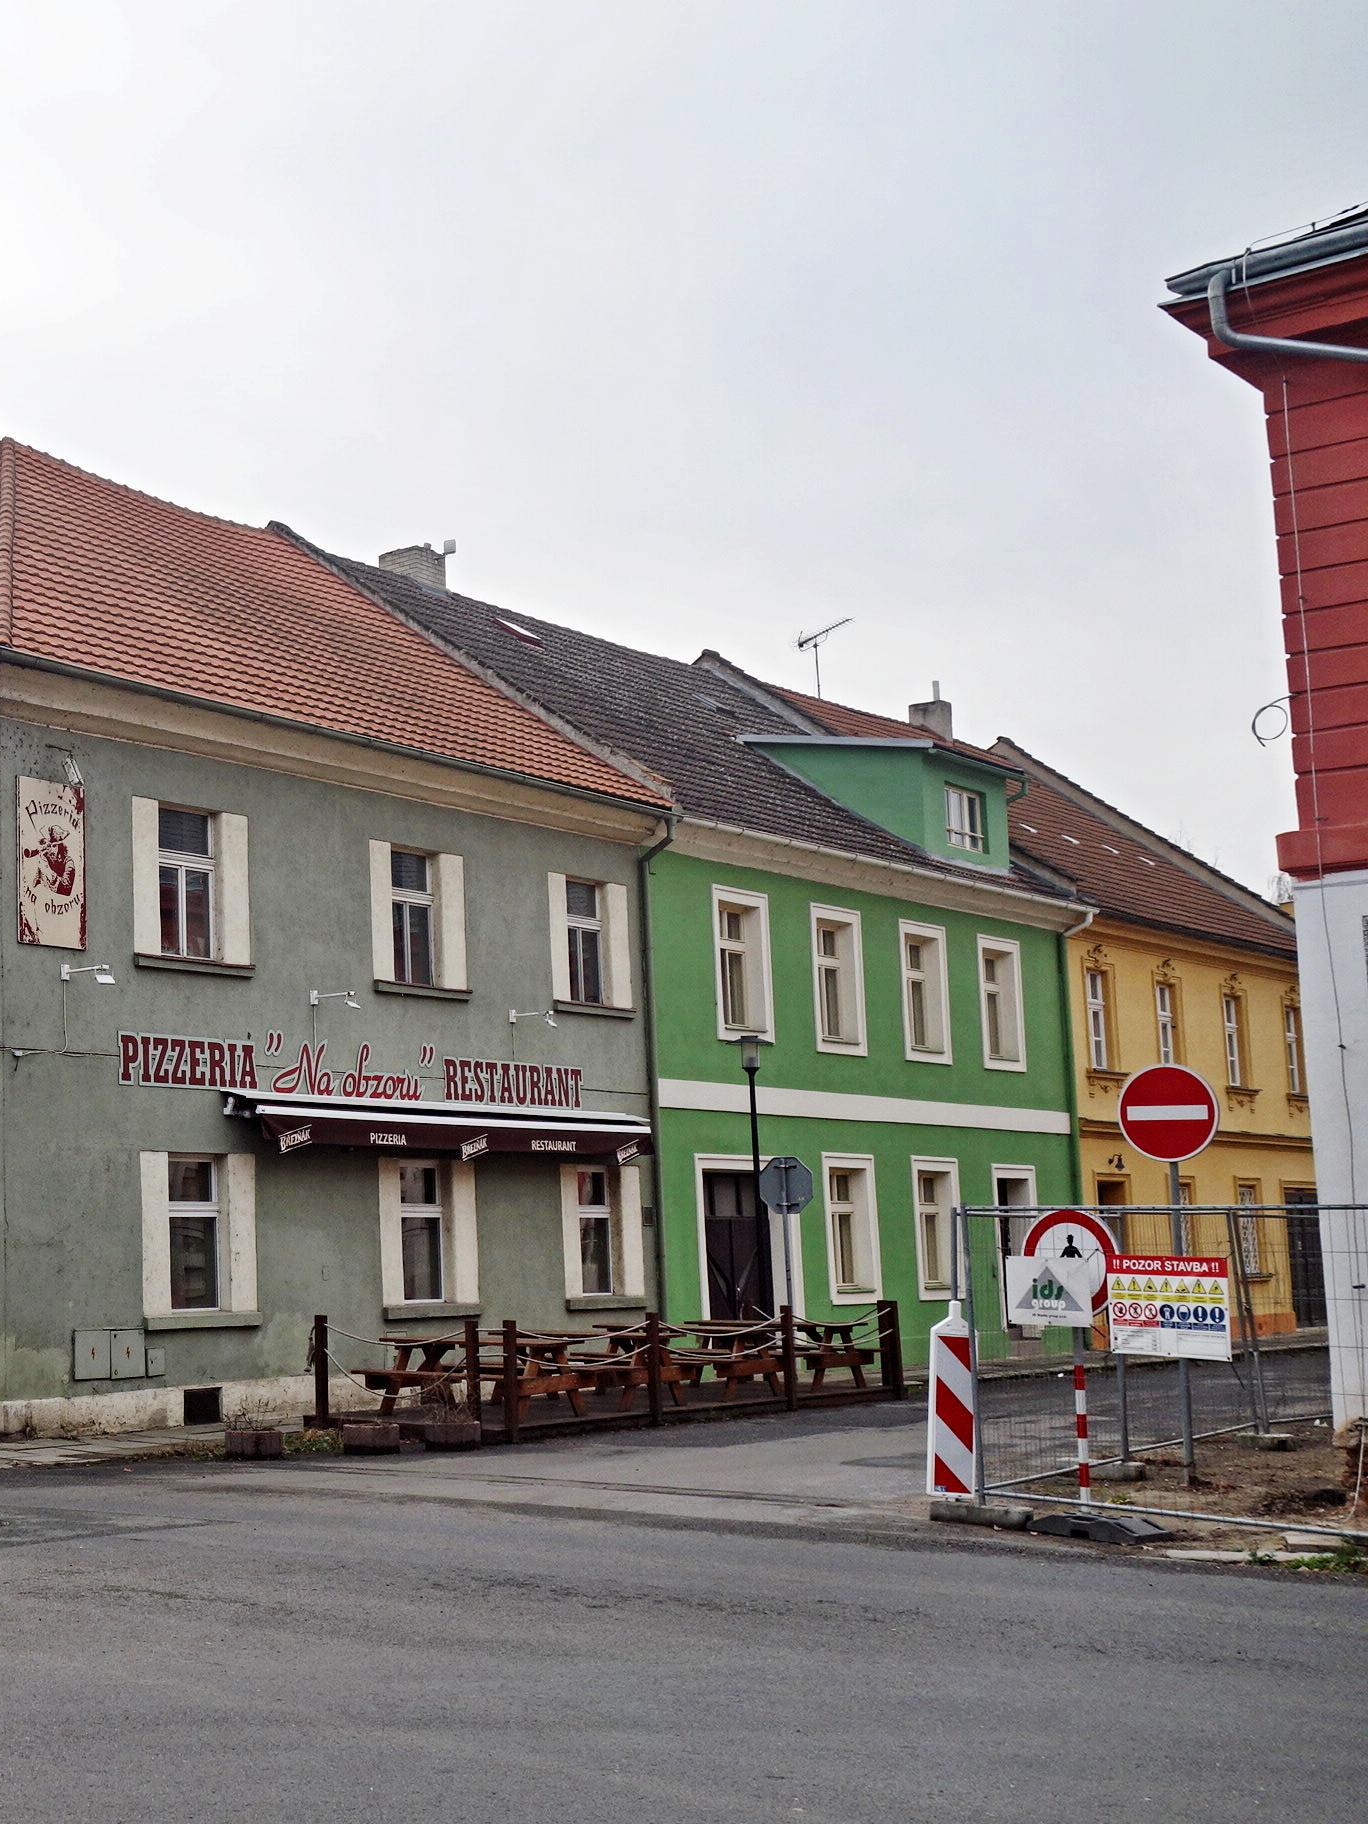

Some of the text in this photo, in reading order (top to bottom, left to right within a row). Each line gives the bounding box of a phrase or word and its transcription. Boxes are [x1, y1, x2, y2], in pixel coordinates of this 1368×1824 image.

[25, 799, 80, 832] Pizzeria
[44, 894, 80, 915] obzoru
[120, 1033, 257, 1089] PIZZERIA
[444, 1059, 582, 1107] RESTAURANT
[370, 1132, 407, 1146] PIZZERIA
[531, 1139, 577, 1152] RESTAURANT
[1122, 1259, 1162, 1271] POZOR
[1164, 1261, 1209, 1273] STAVBA
[1032, 1278, 1064, 1300] ids
[1031, 1300, 1067, 1311] group
